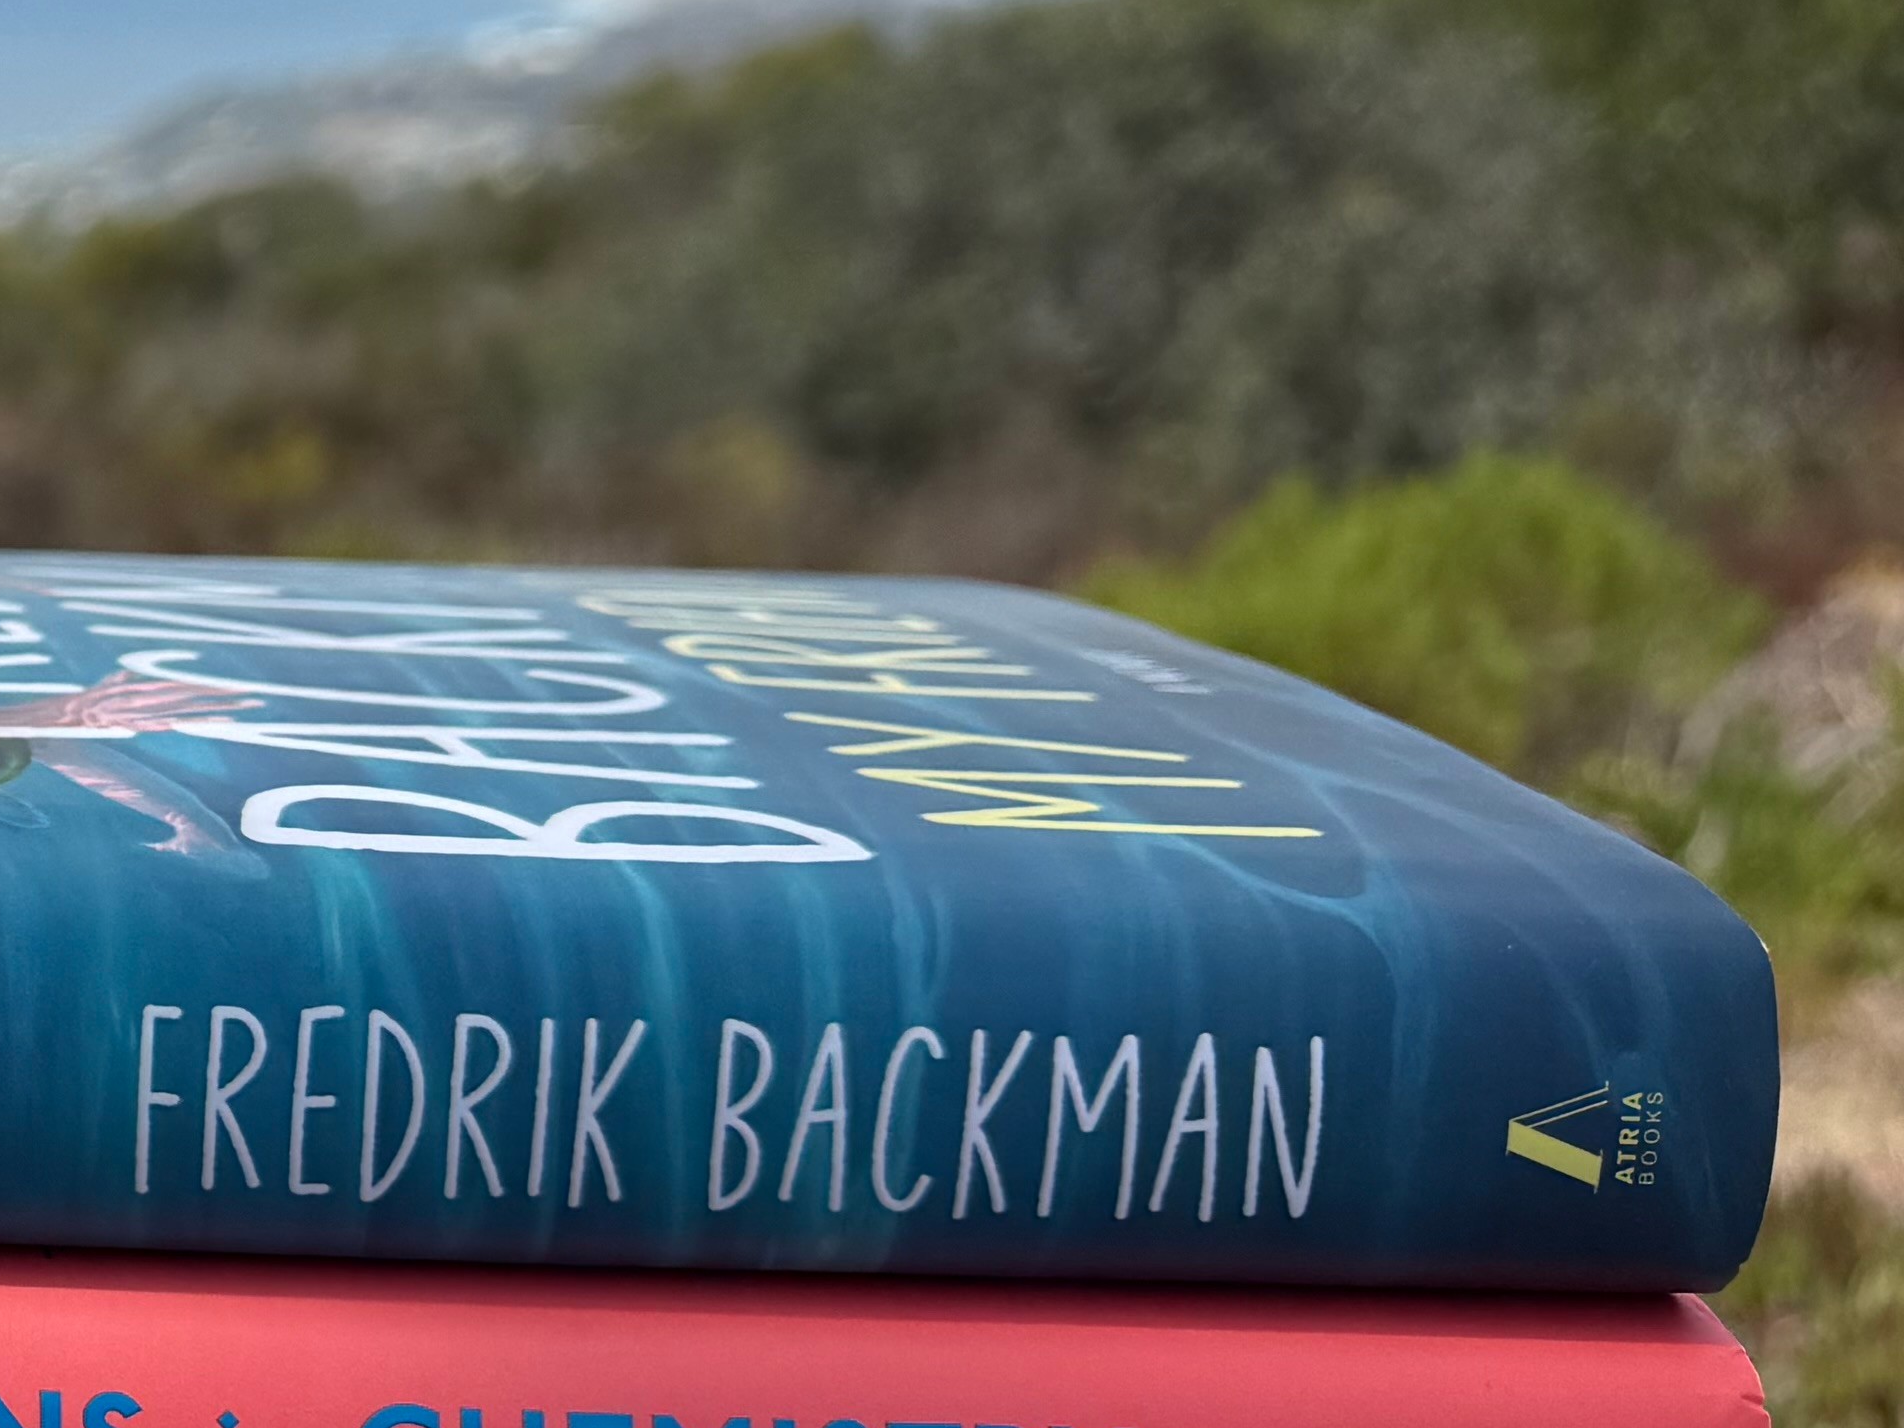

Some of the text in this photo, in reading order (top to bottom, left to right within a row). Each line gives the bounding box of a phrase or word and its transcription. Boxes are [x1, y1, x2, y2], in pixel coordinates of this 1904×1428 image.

[783, 712, 1324, 839] MY
[135, 1003, 1326, 1224] FREDRIK BACKMAN
[1614, 1092, 1643, 1185] ATRIA
[1638, 1091, 1665, 1185] BOOKS
